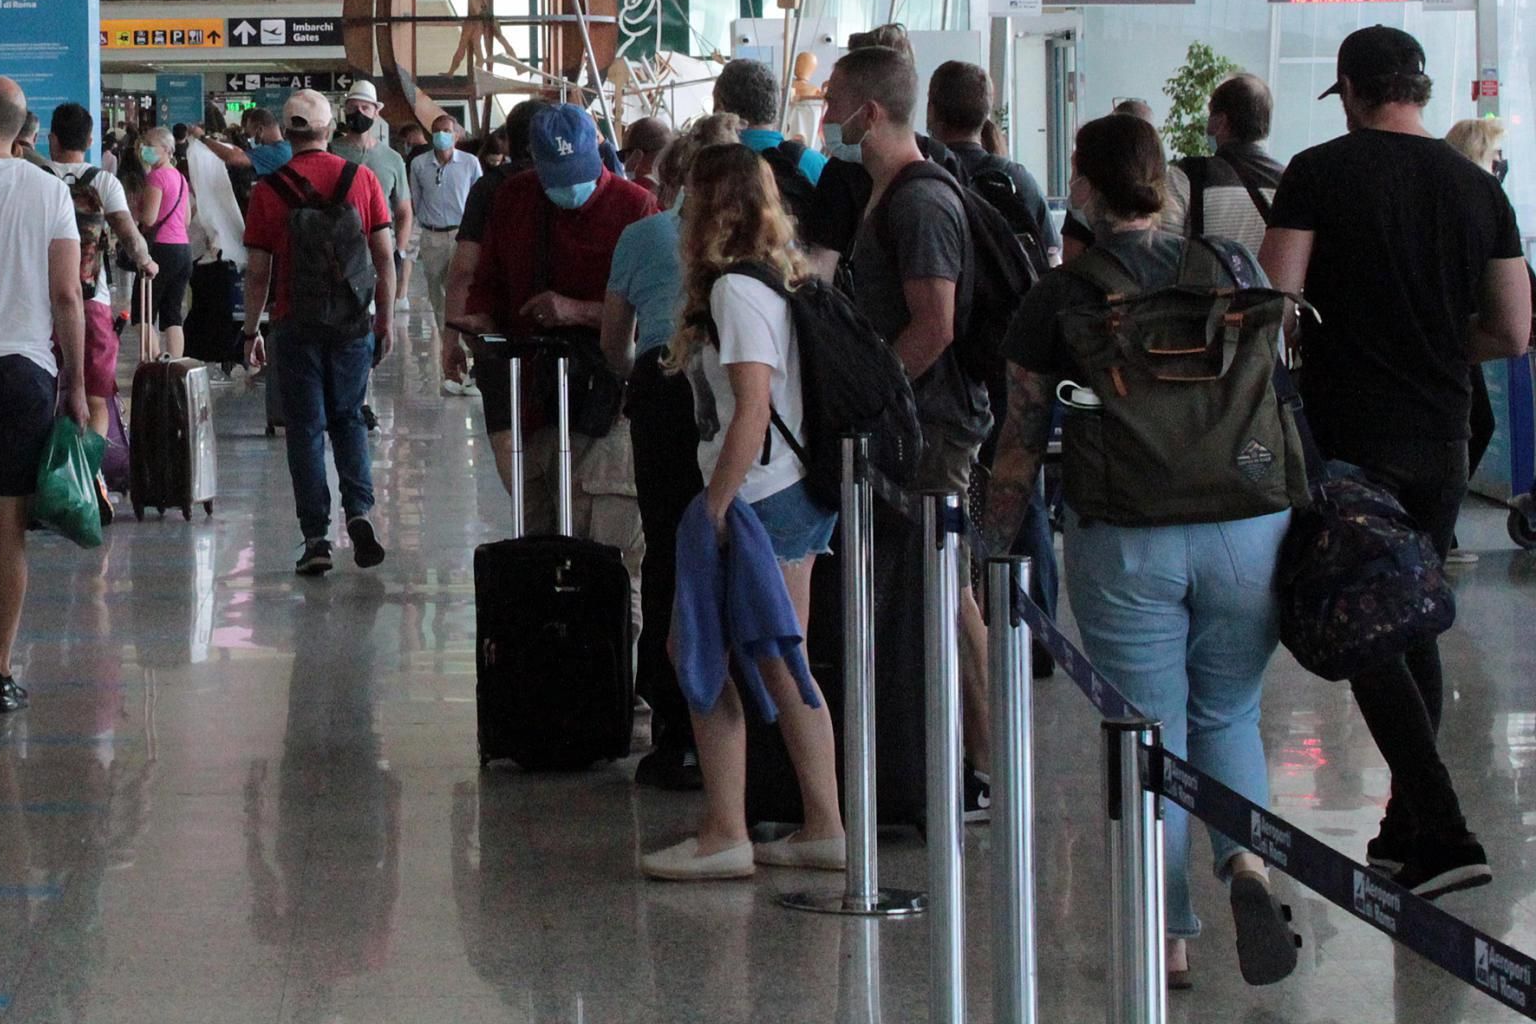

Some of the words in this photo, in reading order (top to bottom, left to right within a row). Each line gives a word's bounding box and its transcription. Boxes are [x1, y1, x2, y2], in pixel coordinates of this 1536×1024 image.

[293, 22, 334, 32] Imbarchi
[293, 33, 320, 42] Gates
[290, 77, 302, 88] A
[305, 77, 312, 88] E
[555, 136, 574, 156] LA
[1489, 945, 1531, 985] Aeroporti
[1500, 976, 1526, 1007] Roma
